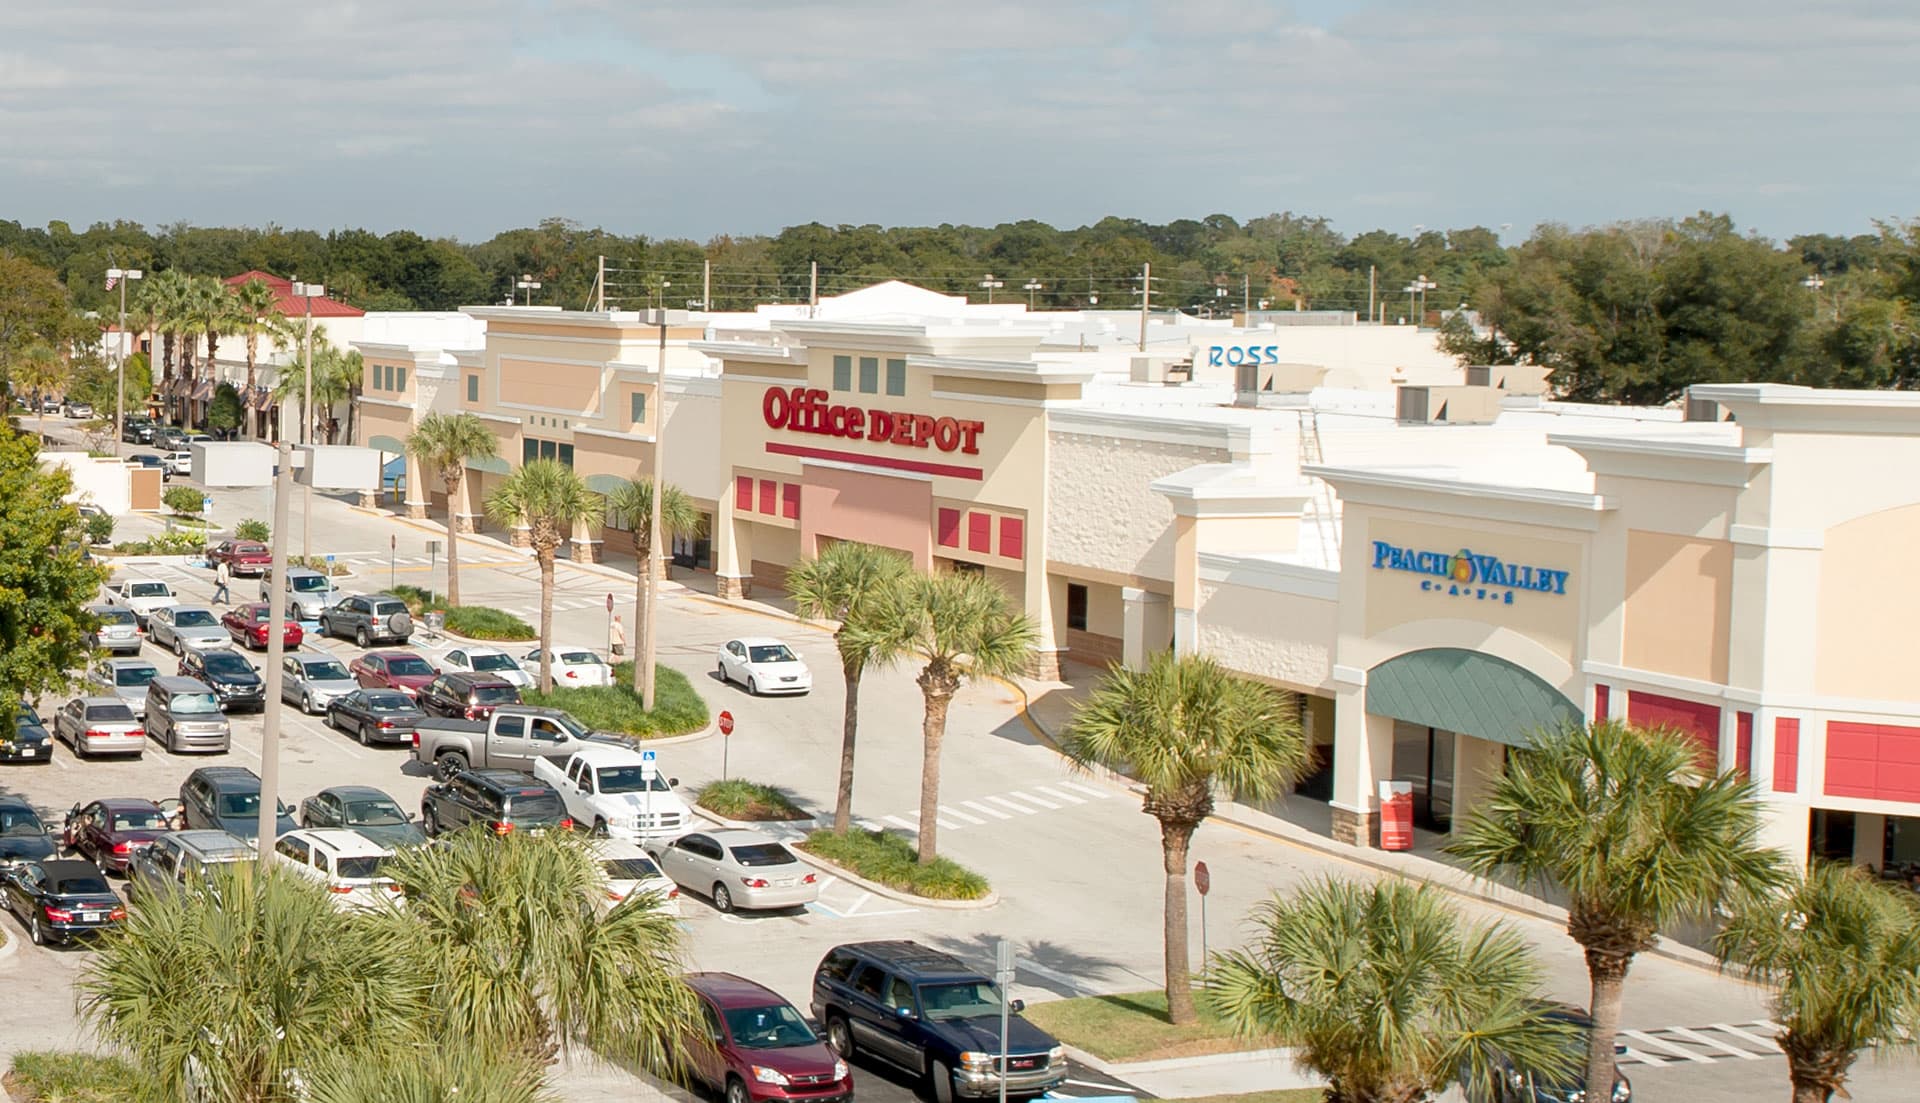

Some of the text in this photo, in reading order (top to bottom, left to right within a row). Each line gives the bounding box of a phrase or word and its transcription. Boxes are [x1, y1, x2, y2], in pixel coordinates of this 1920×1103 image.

[1209, 346, 1278, 366] ROSS
[763, 387, 984, 455] Office DEPOT
[1373, 541, 1569, 594] PEACH VALLEY
